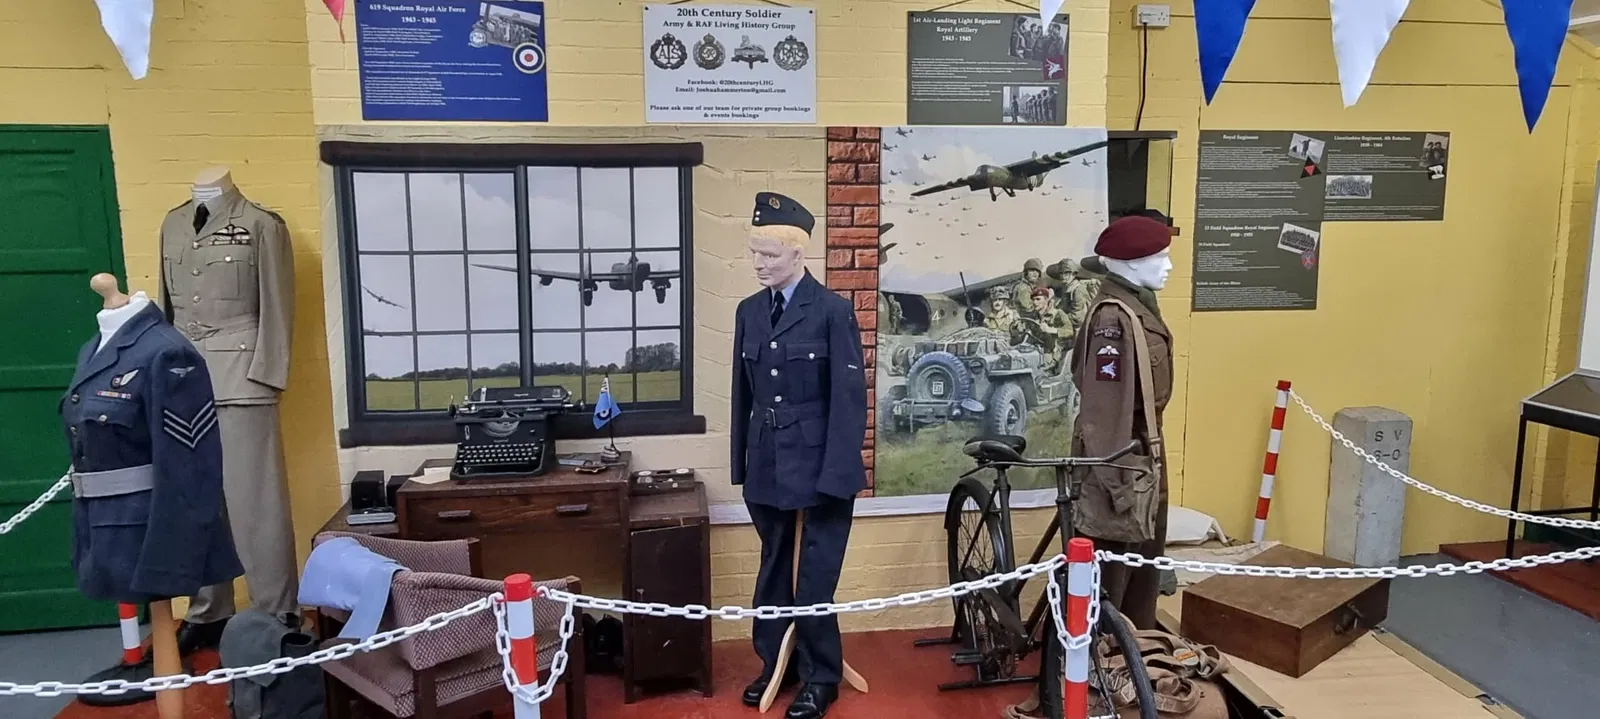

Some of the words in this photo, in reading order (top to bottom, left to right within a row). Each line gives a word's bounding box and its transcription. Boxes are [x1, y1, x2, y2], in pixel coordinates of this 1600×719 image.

[382, 4, 414, 12] Squadron
[415, 5, 435, 13] Royal
[676, 8, 698, 17] 20th
[701, 9, 742, 20] Century
[745, 10, 782, 19] Soldier
[663, 20, 684, 28] Army
[714, 21, 740, 30] Living
[741, 22, 769, 30] History
[771, 23, 796, 31] Group
[922, 17, 957, 25] Air-Landing
[936, 26, 953, 34] Royal
[719, 79, 773, 87] @20thcenturyLHG
[931, 310, 941, 324] 4
[1374, 430, 1384, 442] S
[1394, 429, 1403, 441] V
